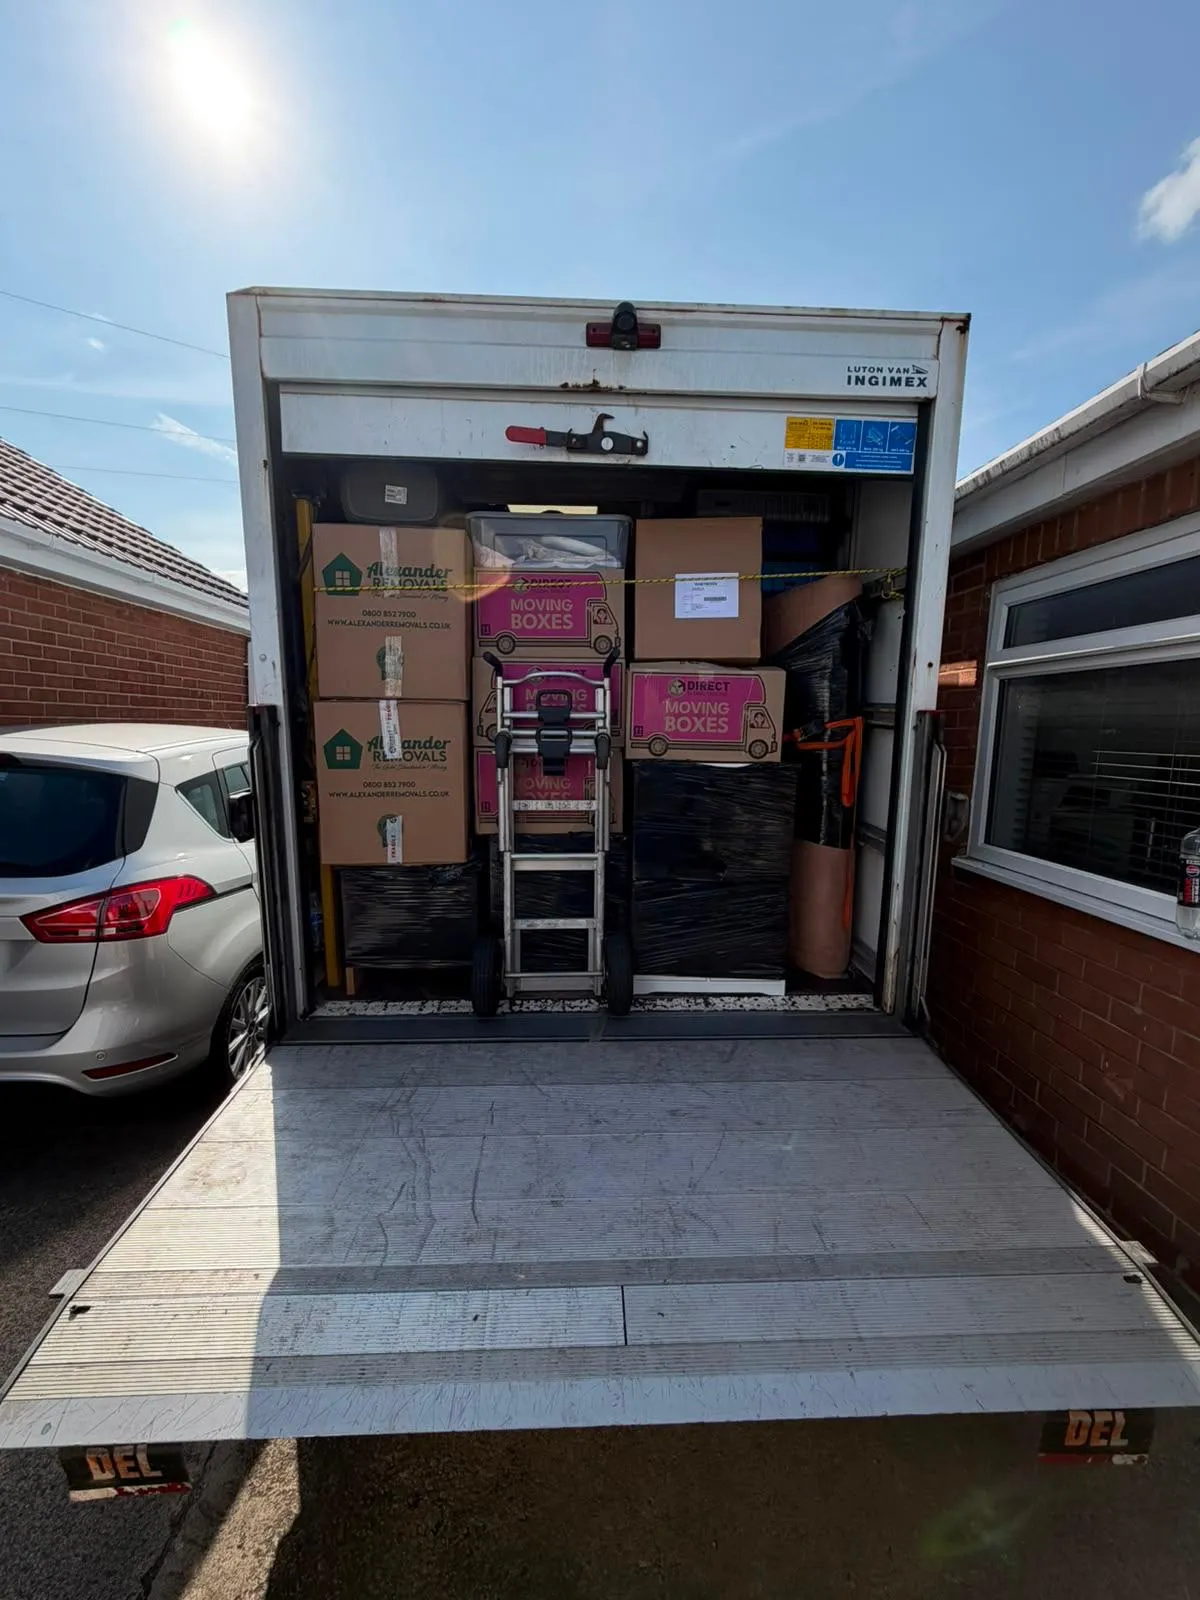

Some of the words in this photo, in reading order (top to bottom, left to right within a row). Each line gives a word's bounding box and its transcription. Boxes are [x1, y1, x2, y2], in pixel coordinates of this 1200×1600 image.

[847, 365, 883, 374] LUTON
[887, 366, 910, 374] VAN
[847, 375, 928, 388] INGIMEX
[510, 599, 573, 612] MOVING
[511, 613, 573, 630] BOXES
[687, 680, 730, 692] DIRECT
[665, 700, 730, 715] MOVING
[664, 716, 729, 733] BOXES
[367, 736, 451, 752] Alander
[373, 750, 447, 762] REOVALS
[519, 777, 571, 790] OVING
[1064, 1410, 1129, 1447] DEL
[86, 1444, 163, 1480] DEL
